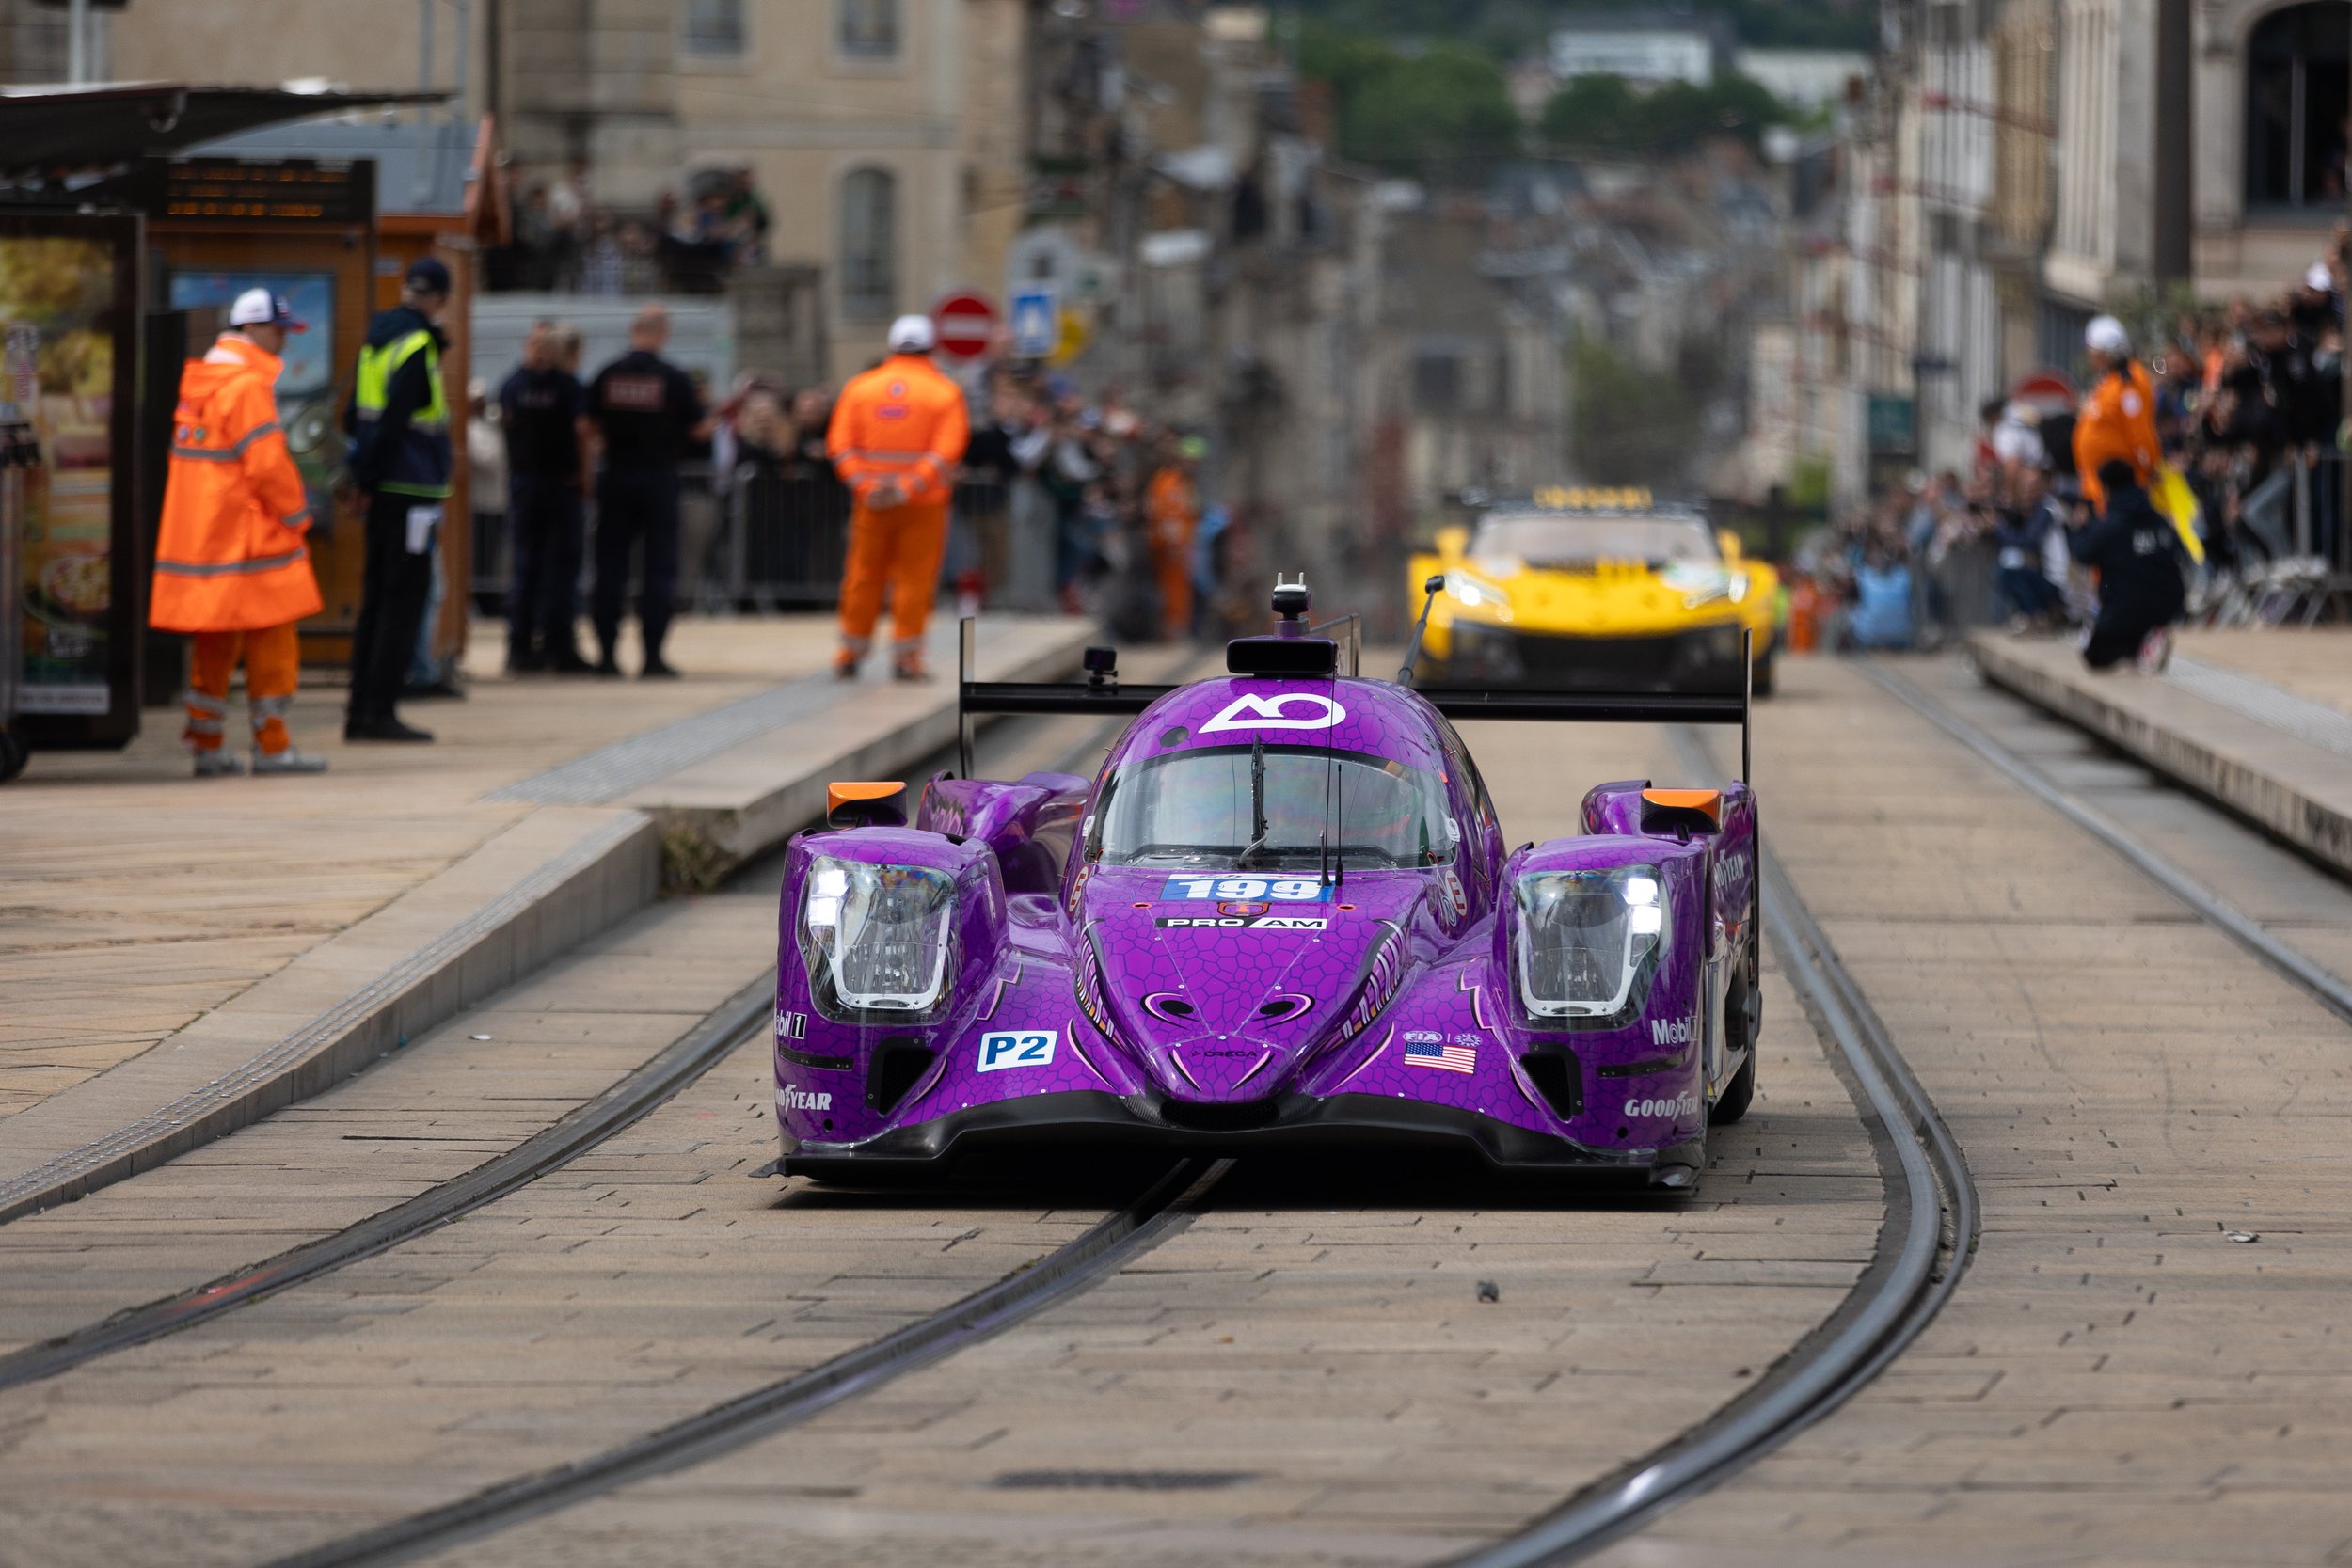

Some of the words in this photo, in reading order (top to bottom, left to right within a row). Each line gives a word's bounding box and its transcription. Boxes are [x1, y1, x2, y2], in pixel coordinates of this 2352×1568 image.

[1178, 879, 1321, 900] 199
[1167, 918, 1245, 927] PRO
[1263, 920, 1324, 928] AM
[1405, 1032, 1439, 1042] FIA
[1651, 1016, 1692, 1046] Mobil
[985, 1036, 1048, 1065] P2
